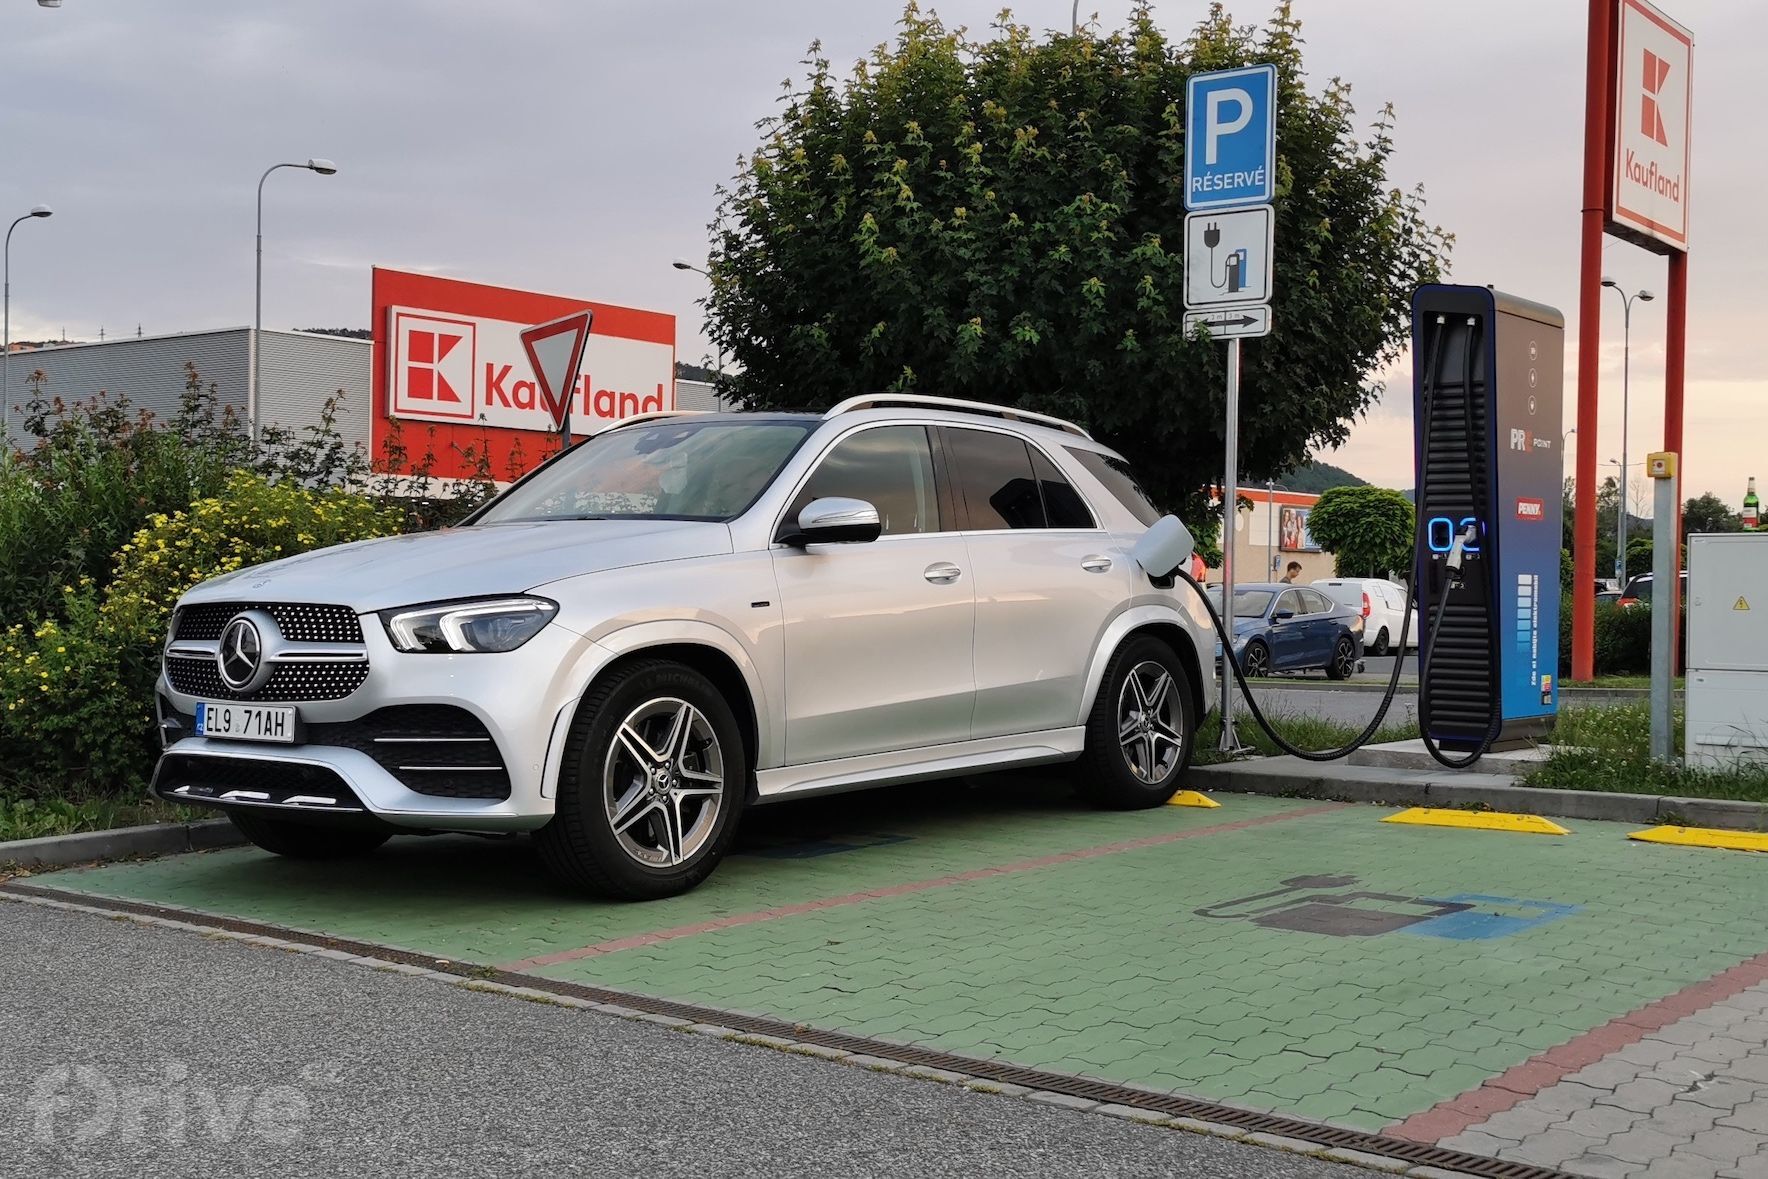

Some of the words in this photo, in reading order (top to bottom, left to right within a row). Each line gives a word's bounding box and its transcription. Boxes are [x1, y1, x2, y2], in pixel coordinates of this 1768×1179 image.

[1205, 87, 1254, 165] P
[1192, 165, 1265, 193] RÉSERVÉ
[1626, 148, 1680, 203] Kaufland
[485, 362, 663, 419] Kafland
[1533, 438, 1551, 449] POINT
[206, 707, 231, 733] EL9
[243, 709, 285, 737] 71AH
